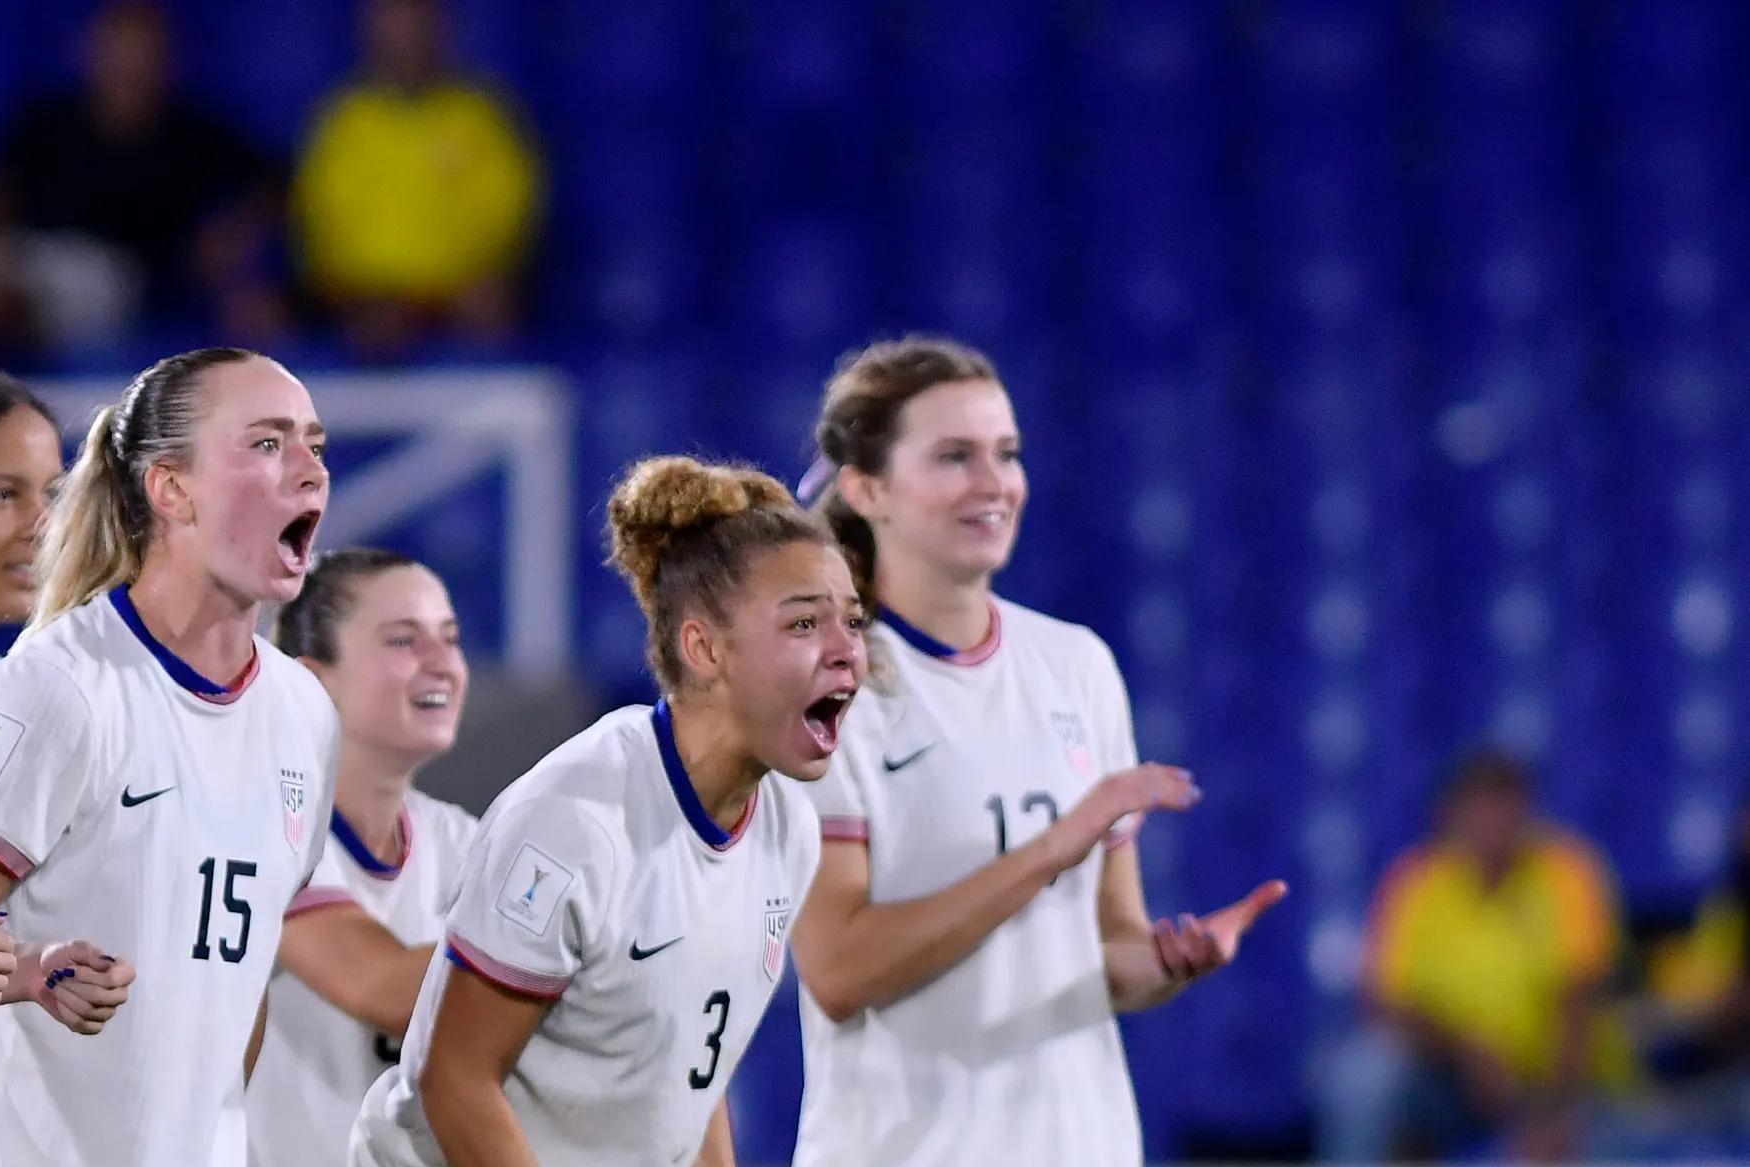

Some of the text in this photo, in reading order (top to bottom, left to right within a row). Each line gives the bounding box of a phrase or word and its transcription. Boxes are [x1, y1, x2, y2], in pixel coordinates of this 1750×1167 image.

[284, 785, 304, 813] USA
[192, 857, 257, 963] 15
[689, 990, 730, 1090] 3
